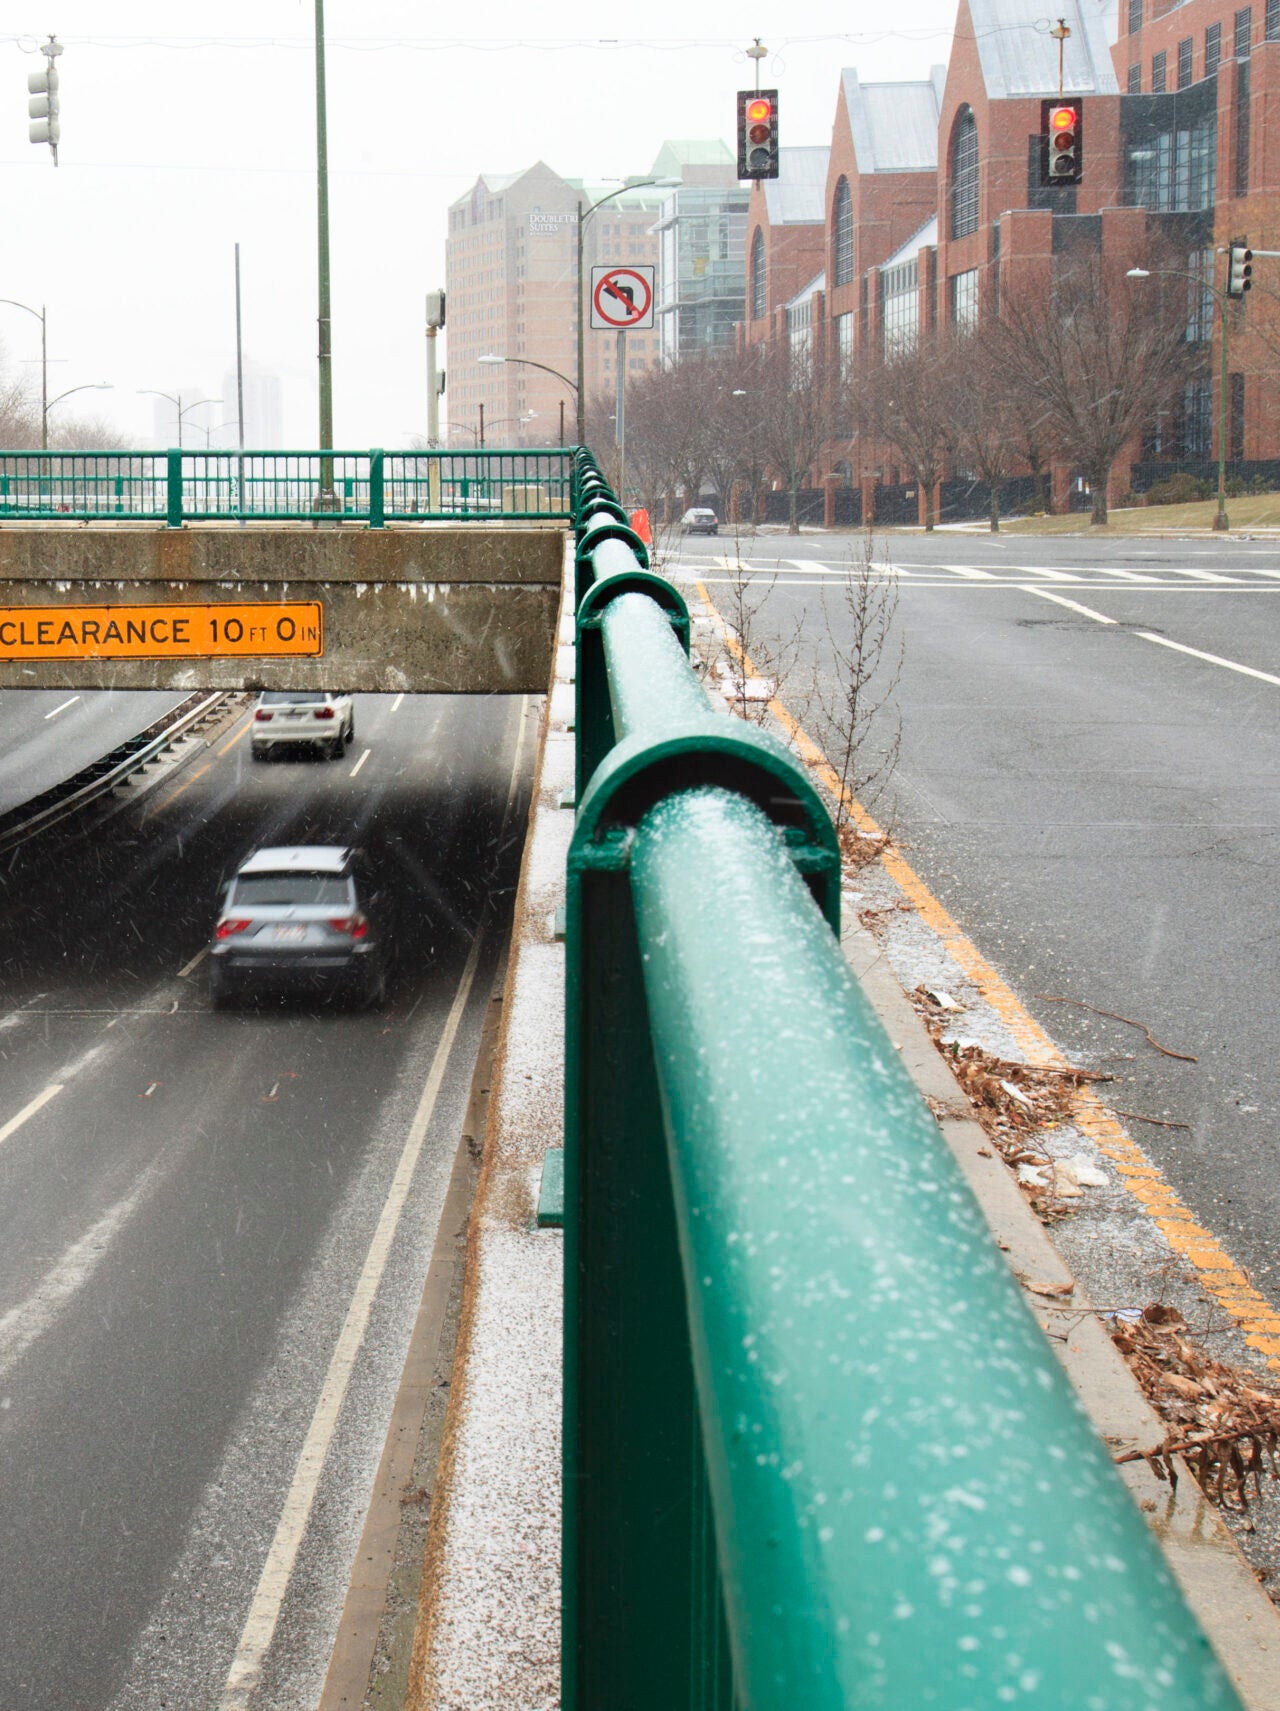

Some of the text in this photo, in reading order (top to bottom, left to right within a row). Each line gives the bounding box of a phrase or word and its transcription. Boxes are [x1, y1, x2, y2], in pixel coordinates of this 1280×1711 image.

[529, 223, 558, 231] SUITES
[209, 618, 243, 642] 10
[249, 627, 267, 642] FT
[276, 617, 296, 642] 0
[301, 627, 317, 641] IN
